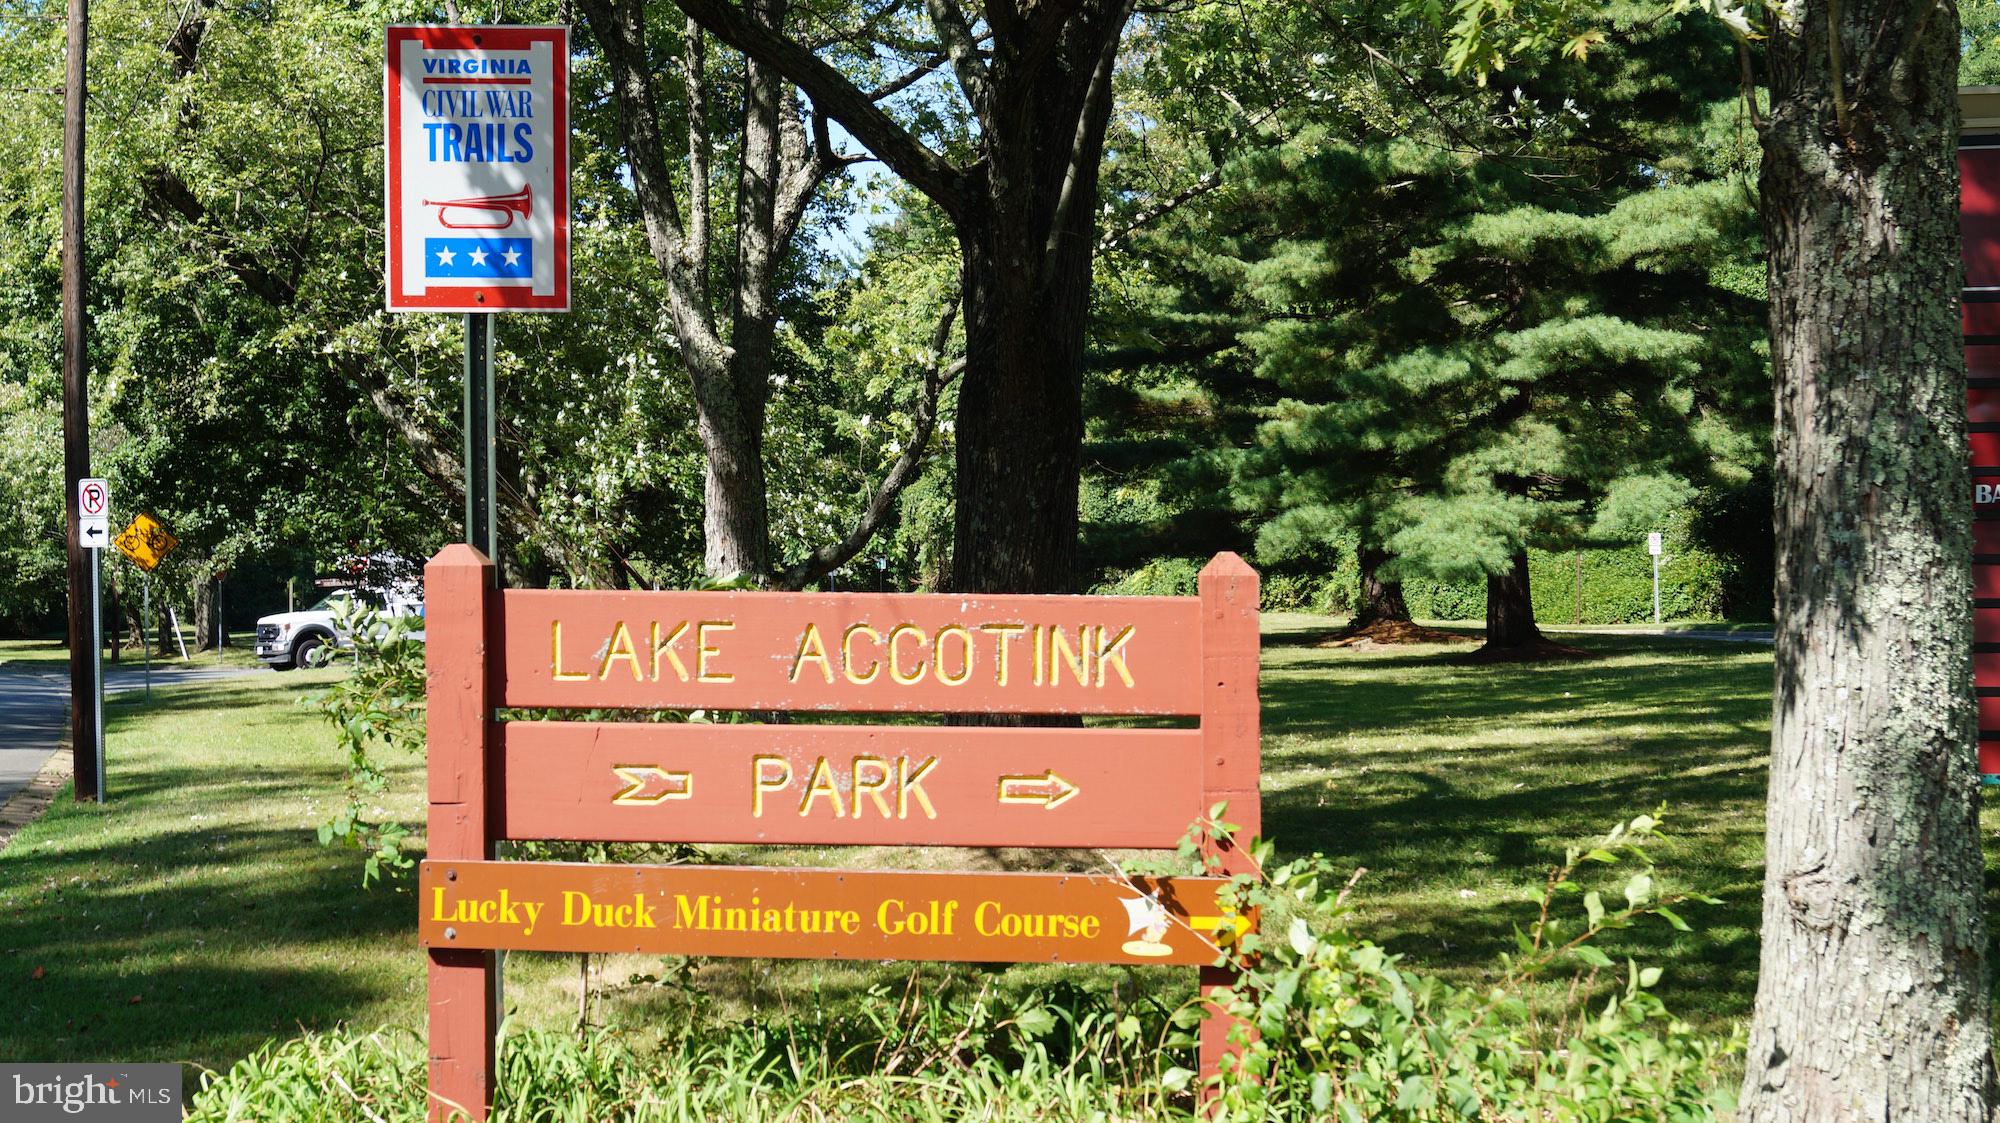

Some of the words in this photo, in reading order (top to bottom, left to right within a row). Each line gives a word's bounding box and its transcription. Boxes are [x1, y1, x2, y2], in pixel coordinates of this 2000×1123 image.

[422, 58, 532, 75] VIRGINIA
[422, 89, 483, 118] CIVIL
[486, 89, 533, 118] WAR
[422, 122, 534, 164] TRAILS
[551, 619, 736, 683] LAKE
[789, 622, 1137, 688] ACCOTINK
[752, 753, 939, 819] PARK
[431, 886, 544, 936] Lucky
[560, 890, 657, 928] Duck
[672, 894, 861, 935] Miniature
[876, 898, 959, 936] Golf
[973, 901, 1101, 939] Course
